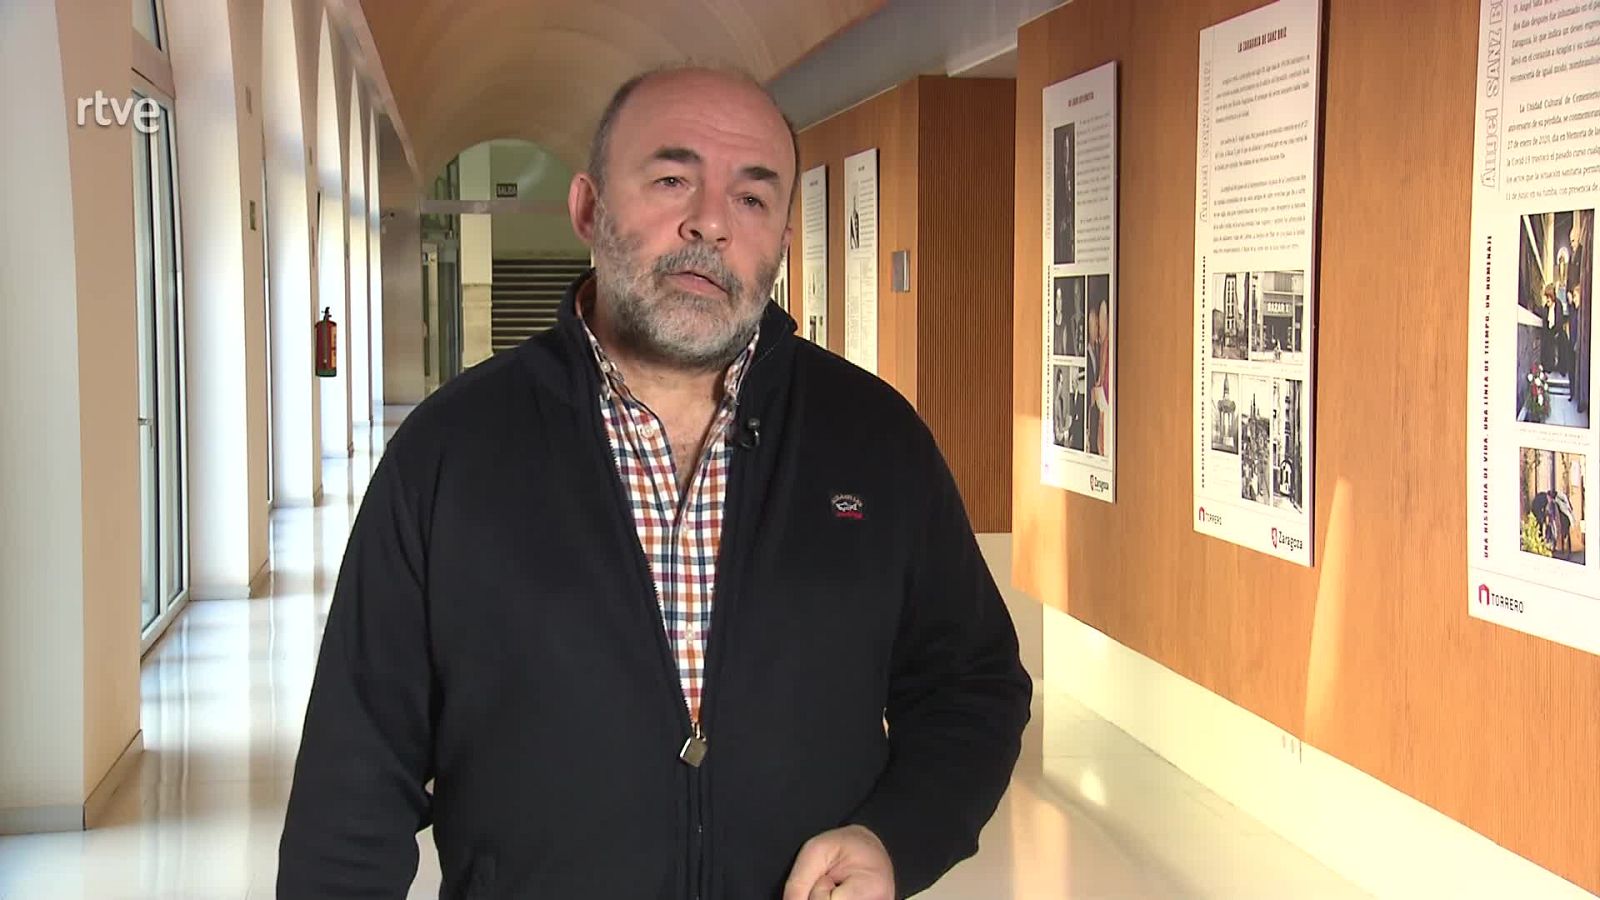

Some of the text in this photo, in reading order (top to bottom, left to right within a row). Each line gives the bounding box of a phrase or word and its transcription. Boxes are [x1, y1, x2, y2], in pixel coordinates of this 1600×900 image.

[1486, 29, 1502, 98] SANZ
[1278, 530, 1303, 552] Zaragoza
[1491, 593, 1524, 614] TORRERO
